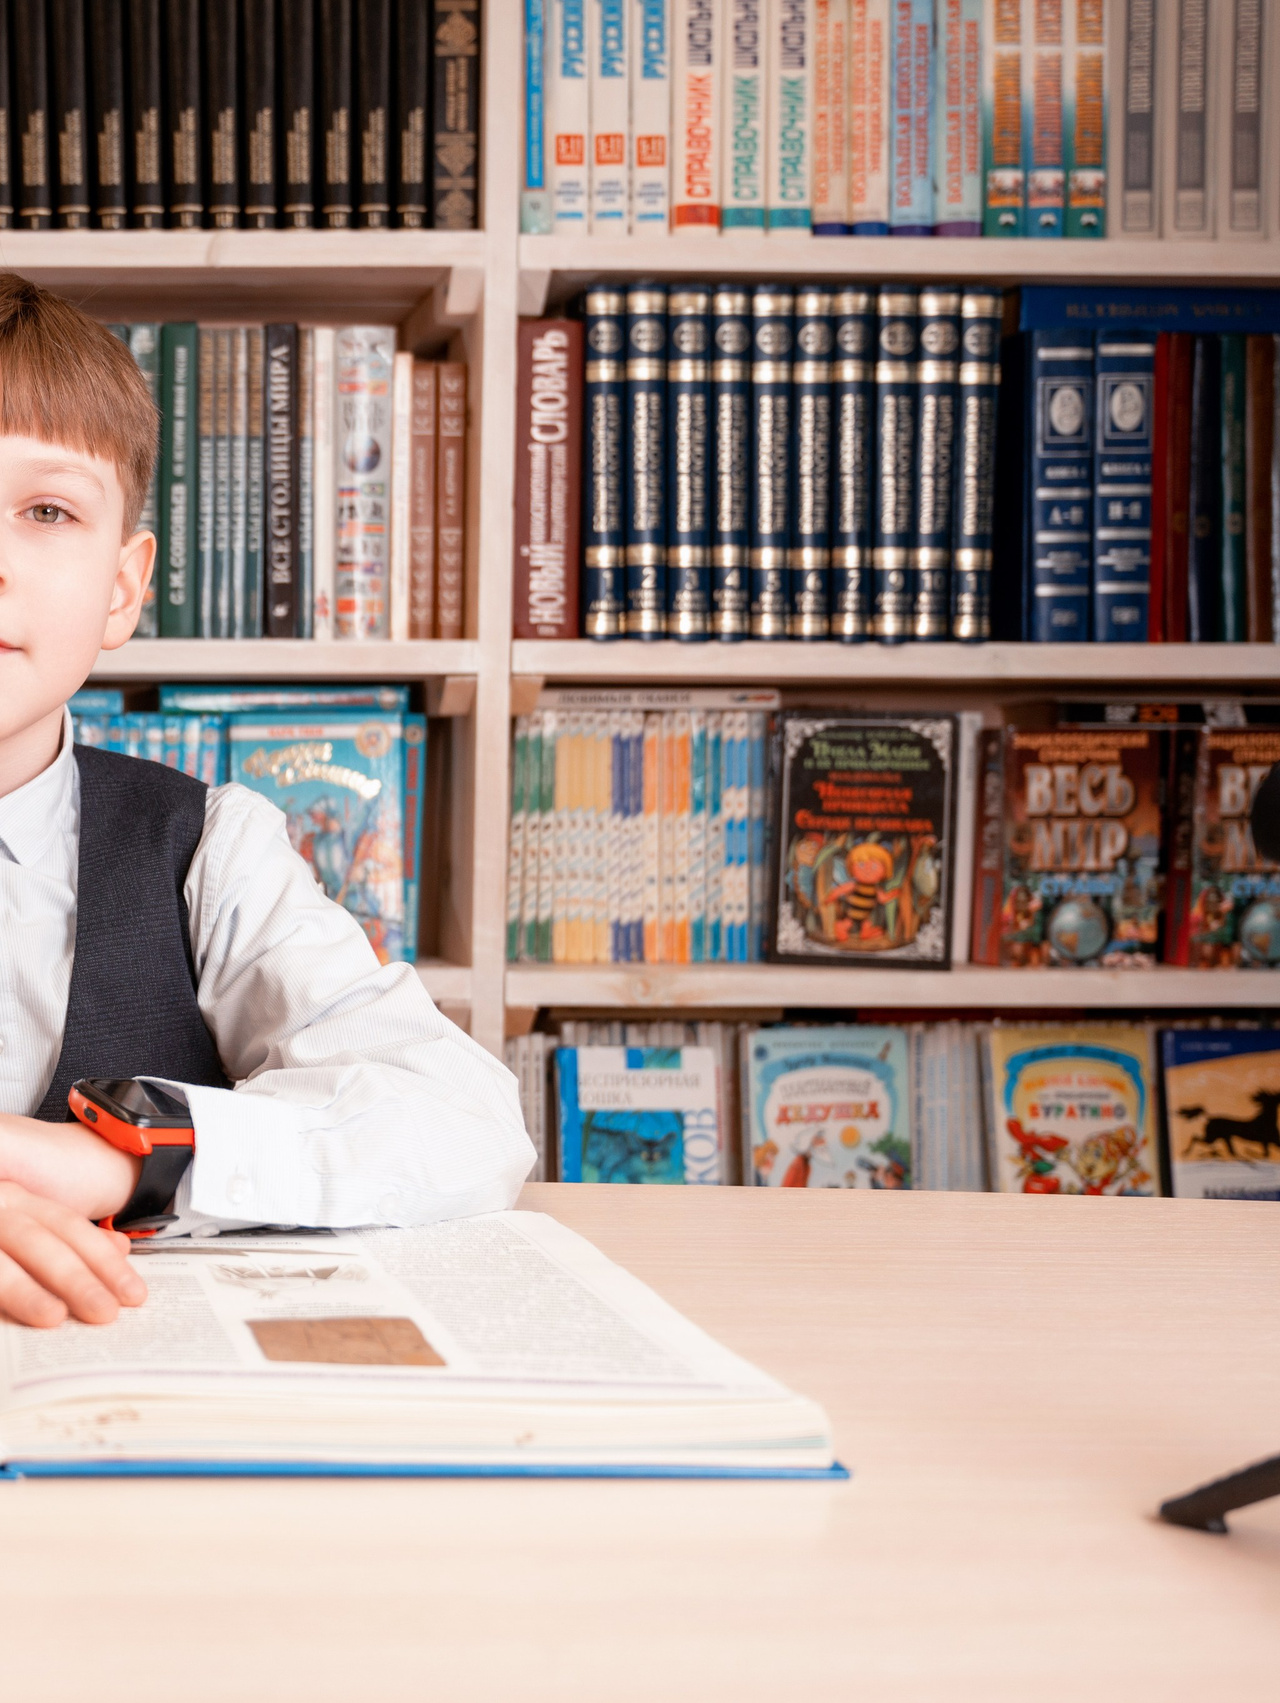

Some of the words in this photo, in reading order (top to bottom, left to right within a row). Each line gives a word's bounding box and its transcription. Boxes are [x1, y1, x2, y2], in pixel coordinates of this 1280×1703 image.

[686, 73, 711, 198] СПРАВОЧНИК
[733, 75, 757, 199] СПРАВОЧНИК
[780, 76, 804, 199] СПРАВОЧНИК
[814, 112, 829, 203] БОЛЬШАЯ
[851, 112, 866, 203] БОЛЬШАЯ
[896, 113, 912, 207] БОЛЬШАЯ
[947, 111, 962, 203] БОЛЬШАЯ
[270, 343, 291, 412] МИРА
[530, 328, 569, 443] СЛОВАРЬ
[270, 414, 293, 537] СТОЛИЦЫ
[271, 540, 292, 584] ВСЕ
[520, 543, 565, 624] НОВЫЙ
[603, 571, 614, 590] 1
[641, 568, 656, 588] 2
[684, 569, 700, 590] 3
[724, 568, 741, 589] 4
[766, 569, 781, 590] 5
[806, 570, 822, 590] 6
[847, 570, 862, 590] 7
[888, 570, 904, 591] 9
[922, 571, 944, 590] 10
[1013, 732, 1149, 749] ЭНЦИКЛОПЕДИЧЕСКИЙ
[1024, 762, 1136, 819] ВЕСЬ
[1029, 818, 1129, 873] МИР
[775, 1100, 881, 1126] ДЕДУШКА
[1025, 1103, 1127, 1120] БУРАТИНО
